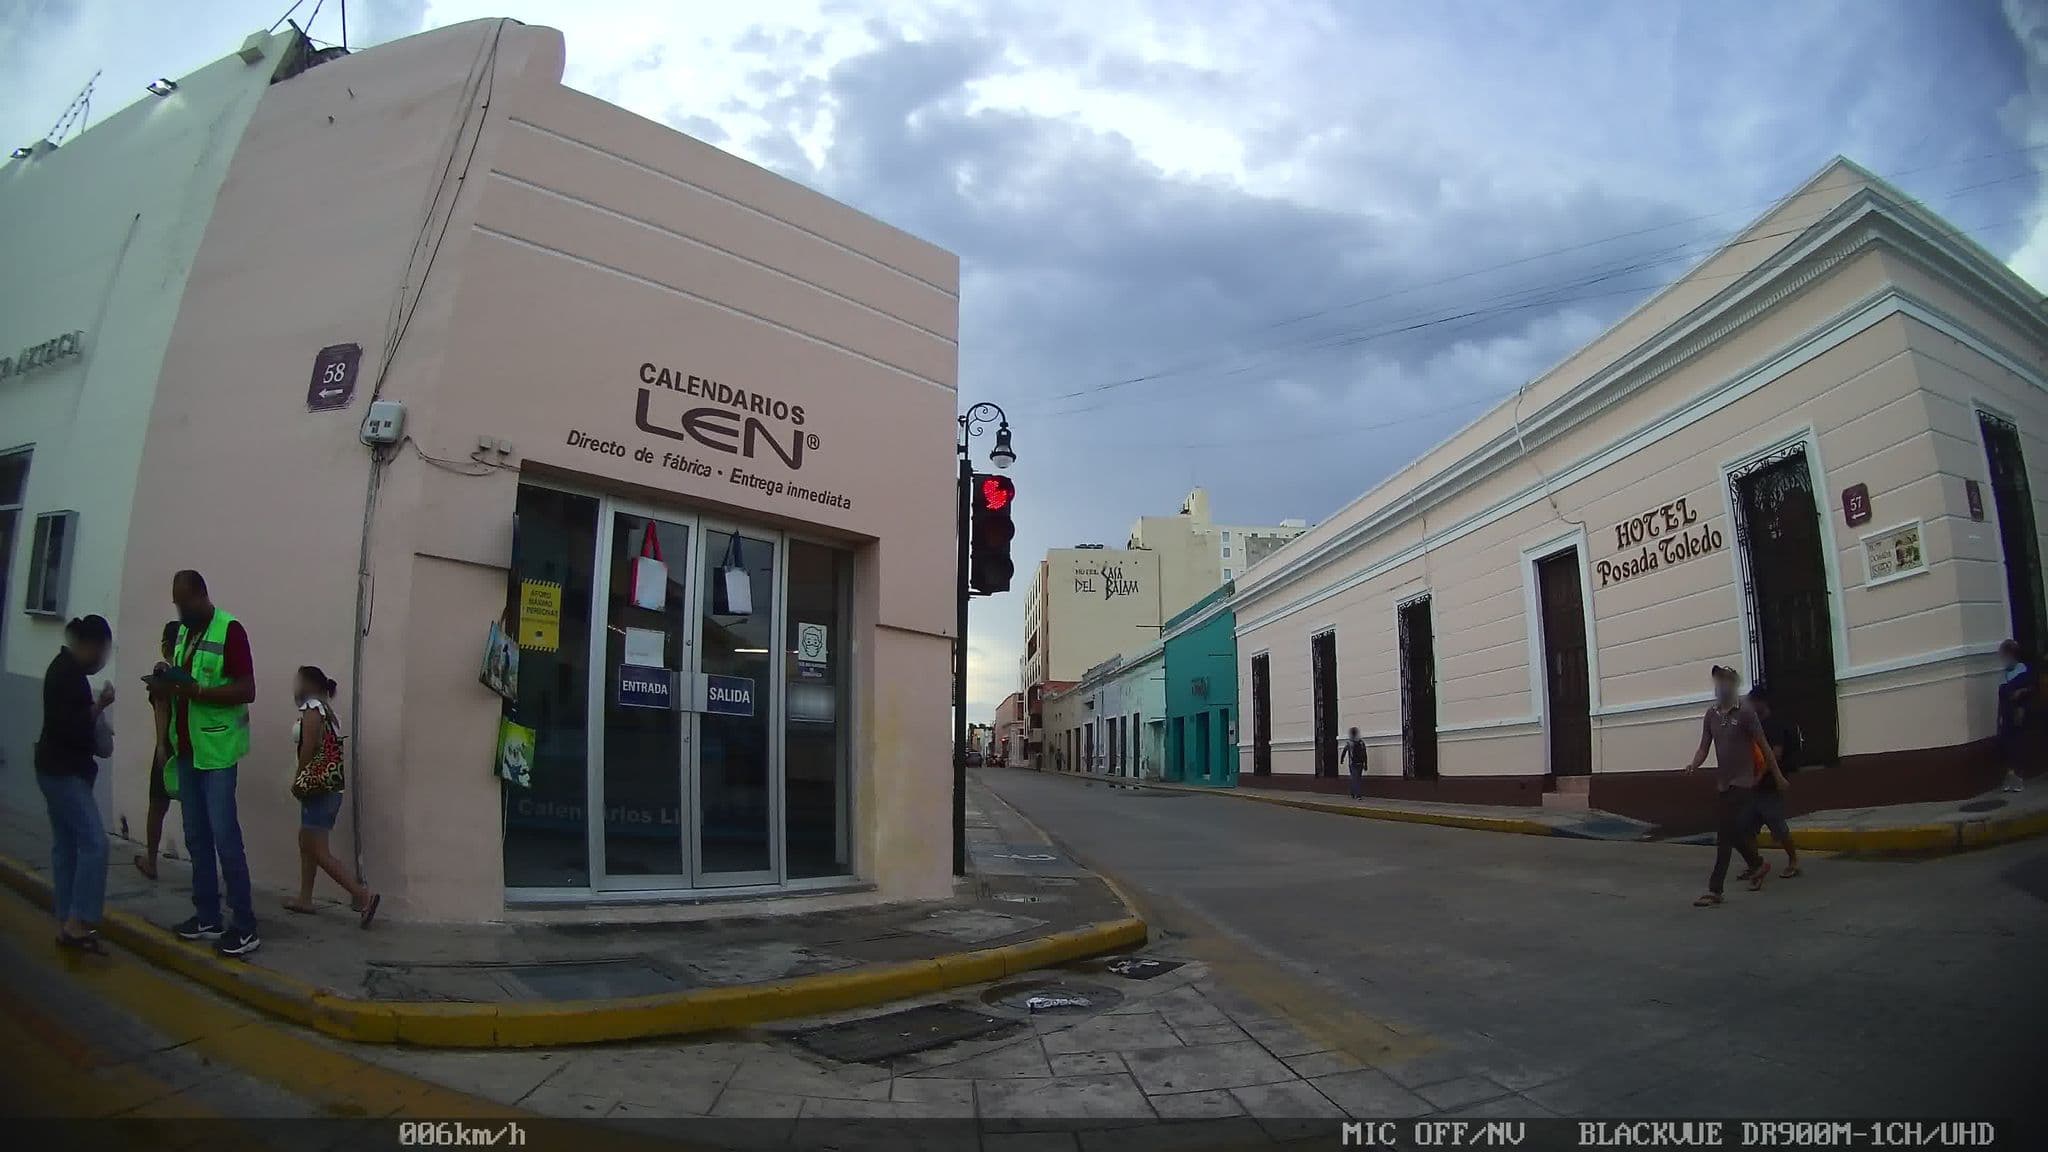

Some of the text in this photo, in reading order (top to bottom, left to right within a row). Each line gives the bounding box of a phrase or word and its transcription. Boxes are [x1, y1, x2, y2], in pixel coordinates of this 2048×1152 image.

[323, 362, 346, 384] 58
[639, 362, 806, 425] CALENDARIOS
[566, 429, 852, 510] Directo de fábrica Entrega inmediata
[1850, 496, 1863, 511] 57
[1614, 497, 1697, 551] HOTEL
[1597, 523, 1723, 586] Posada Toledo
[1075, 578, 1139, 600] DEL BALAM
[622, 680, 668, 695] ENTRADA
[709, 687, 751, 704] SALIDA
